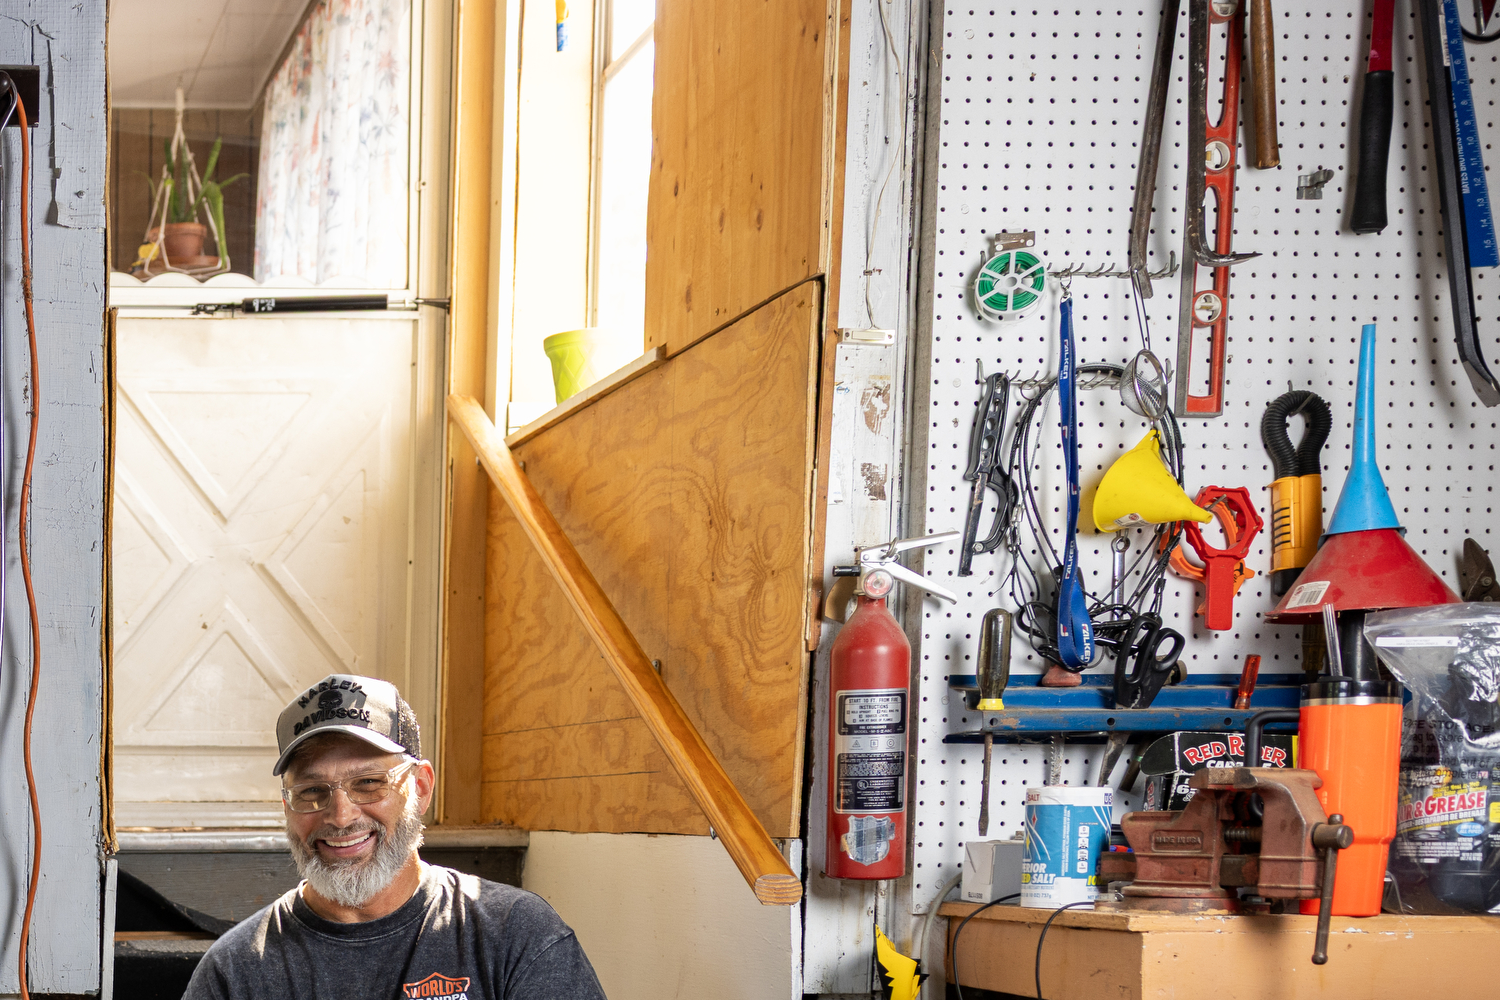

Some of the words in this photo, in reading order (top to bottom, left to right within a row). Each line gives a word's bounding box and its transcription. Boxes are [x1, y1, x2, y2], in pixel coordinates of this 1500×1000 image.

[1461, 172, 1471, 194] MAYES
[1082, 624, 1091, 662] FALKEN
[294, 708, 370, 736] DAVIDSON
[1184, 742, 1226, 766] RED
[1228, 736, 1287, 768] RER
[1424, 792, 1486, 816] GREASE
[1032, 873, 1056, 884] SALT
[410, 980, 463, 998] WORLD'S
